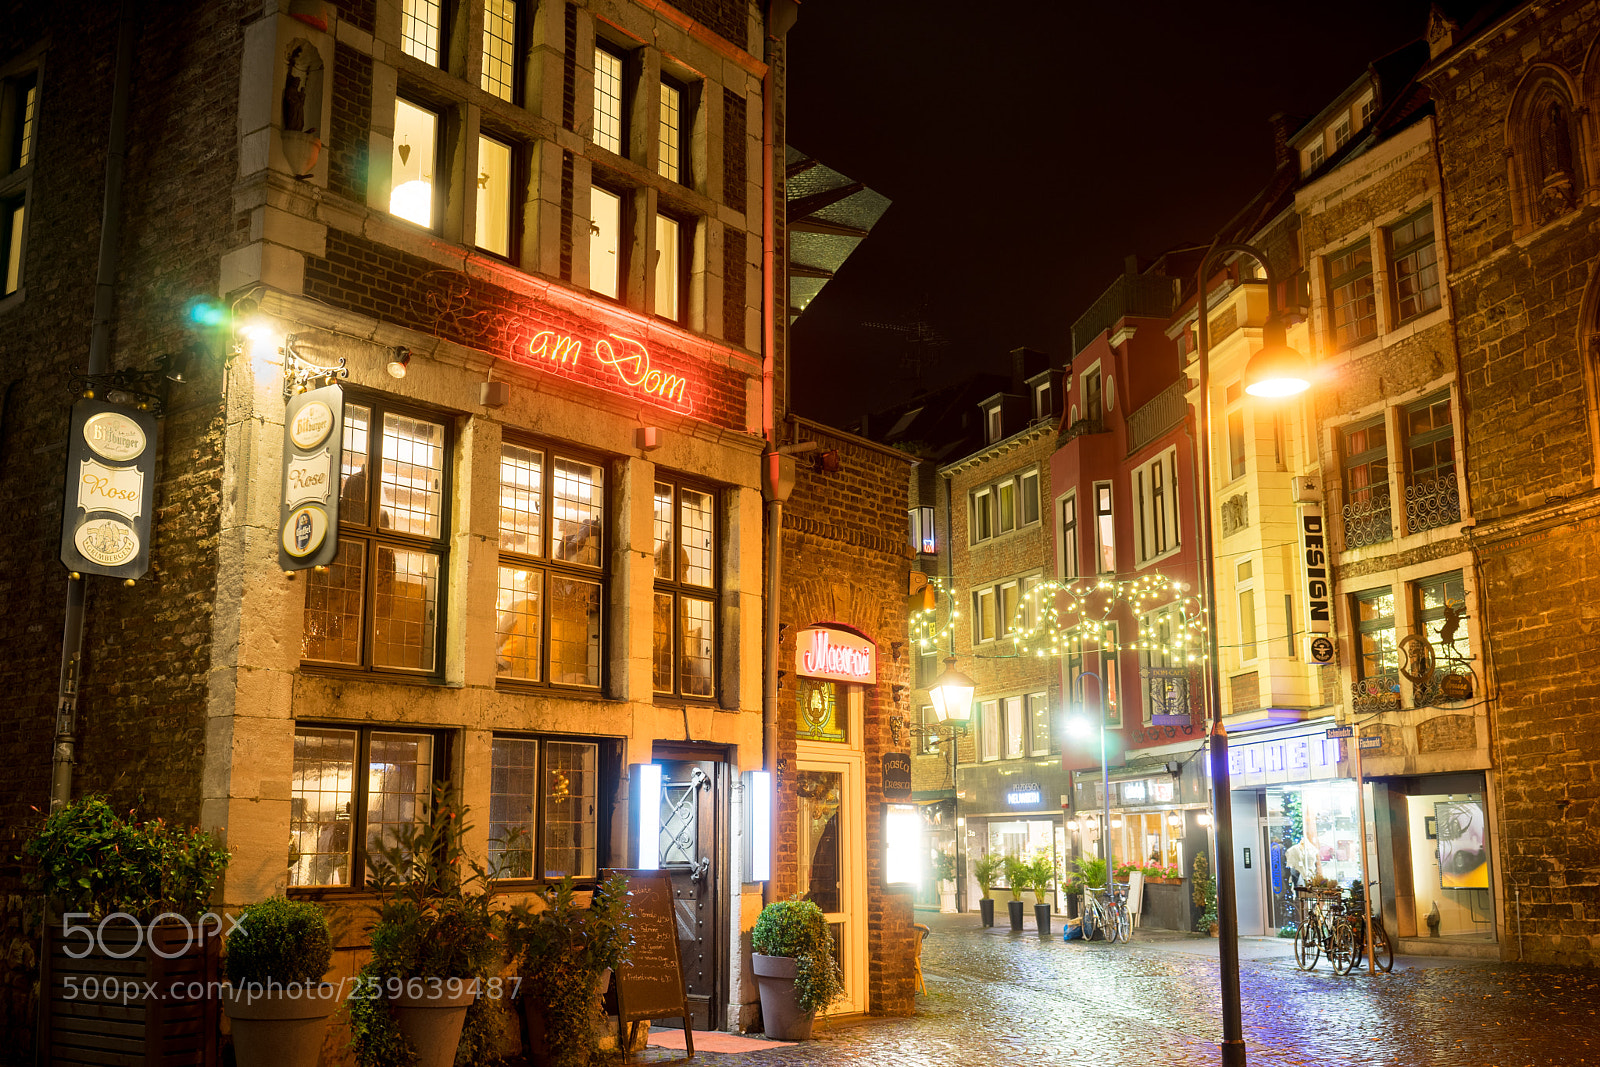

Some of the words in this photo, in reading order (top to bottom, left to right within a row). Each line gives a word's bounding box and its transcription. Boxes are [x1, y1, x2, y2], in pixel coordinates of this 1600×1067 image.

[529, 330, 582, 366] am
[595, 333, 687, 403] Dom
[83, 473, 139, 502] Rose
[289, 468, 326, 490] Rose
[85, 544, 133, 563] GRIMBERGEN
[1303, 514, 1329, 621] DESIGN
[884, 760, 910, 775] pasta
